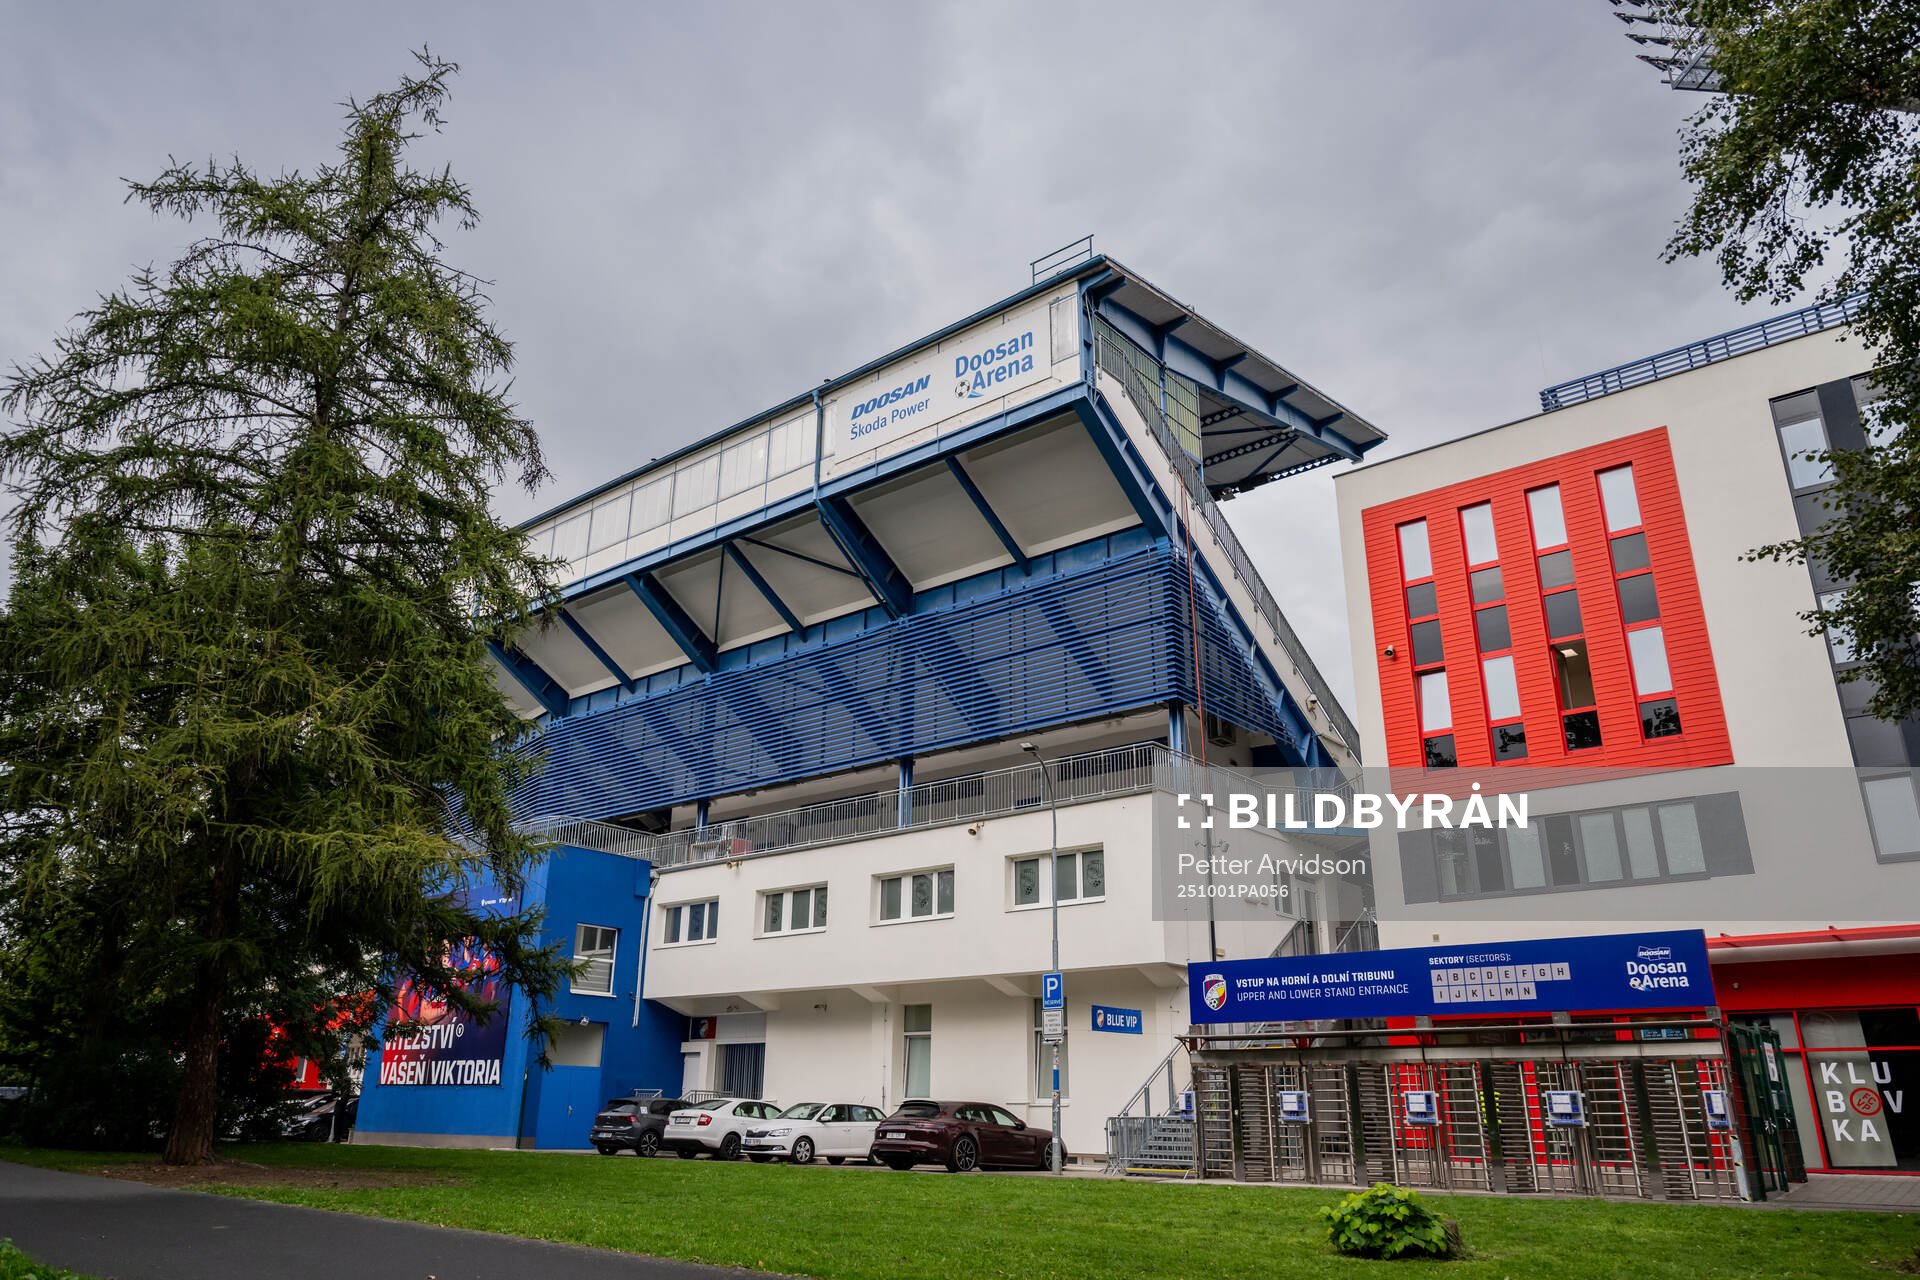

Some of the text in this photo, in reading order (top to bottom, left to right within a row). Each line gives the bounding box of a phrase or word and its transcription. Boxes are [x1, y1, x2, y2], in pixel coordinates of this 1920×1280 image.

[956, 332, 1032, 378] Doosan
[972, 354, 1034, 390] Arena
[851, 374, 931, 420] DOOSAN
[850, 398, 930, 440] Škoda Power
[1429, 954, 1512, 965] SEKTORY (SECTORS):
[1626, 962, 1686, 975] Doosan
[1236, 970, 1395, 988] VSTUP NA HORNÍ A DOLNÍ TRIBUNU
[1436, 968, 1564, 982] A B C D E F G H
[1642, 974, 1690, 988] Arena
[1046, 978, 1058, 998] P
[1237, 984, 1409, 1002] UPPER AND LOWER STAND ENTRANCE
[1472, 989, 1478, 997] K
[1505, 988, 1514, 996] M
[1524, 987, 1530, 995] N
[1106, 1013, 1138, 1028] BLUE VIP
[380, 1054, 500, 1084] VÁŠEŇ VIKTORIA
